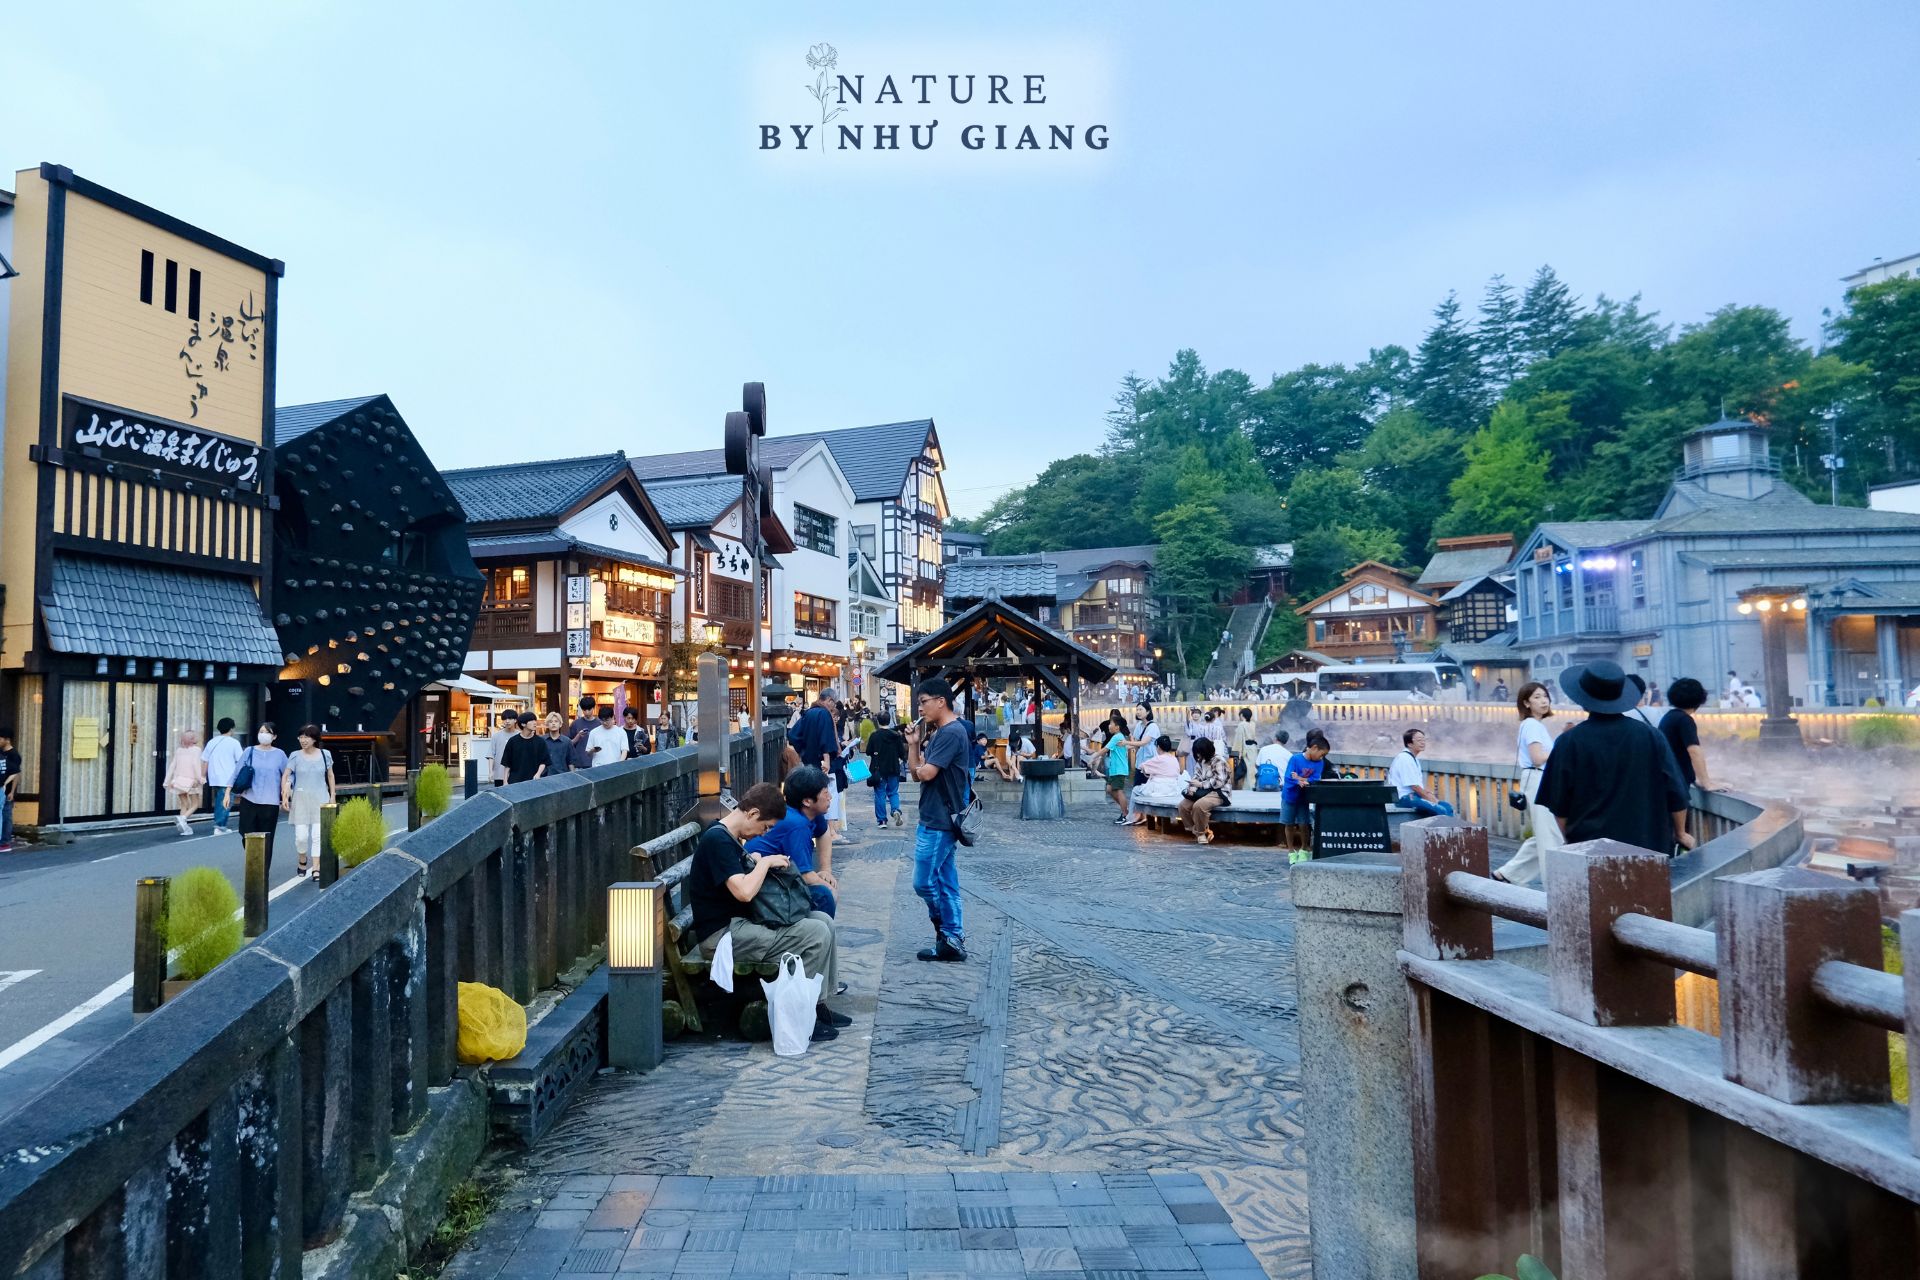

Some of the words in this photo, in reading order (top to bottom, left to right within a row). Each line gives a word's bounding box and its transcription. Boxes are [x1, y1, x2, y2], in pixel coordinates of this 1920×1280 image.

[208, 311, 235, 372] 温泉
[237, 289, 265, 361] 山びこ
[75, 413, 260, 482] 山びこ温泉まんじゅう
[716, 553, 750, 576] ちちや
